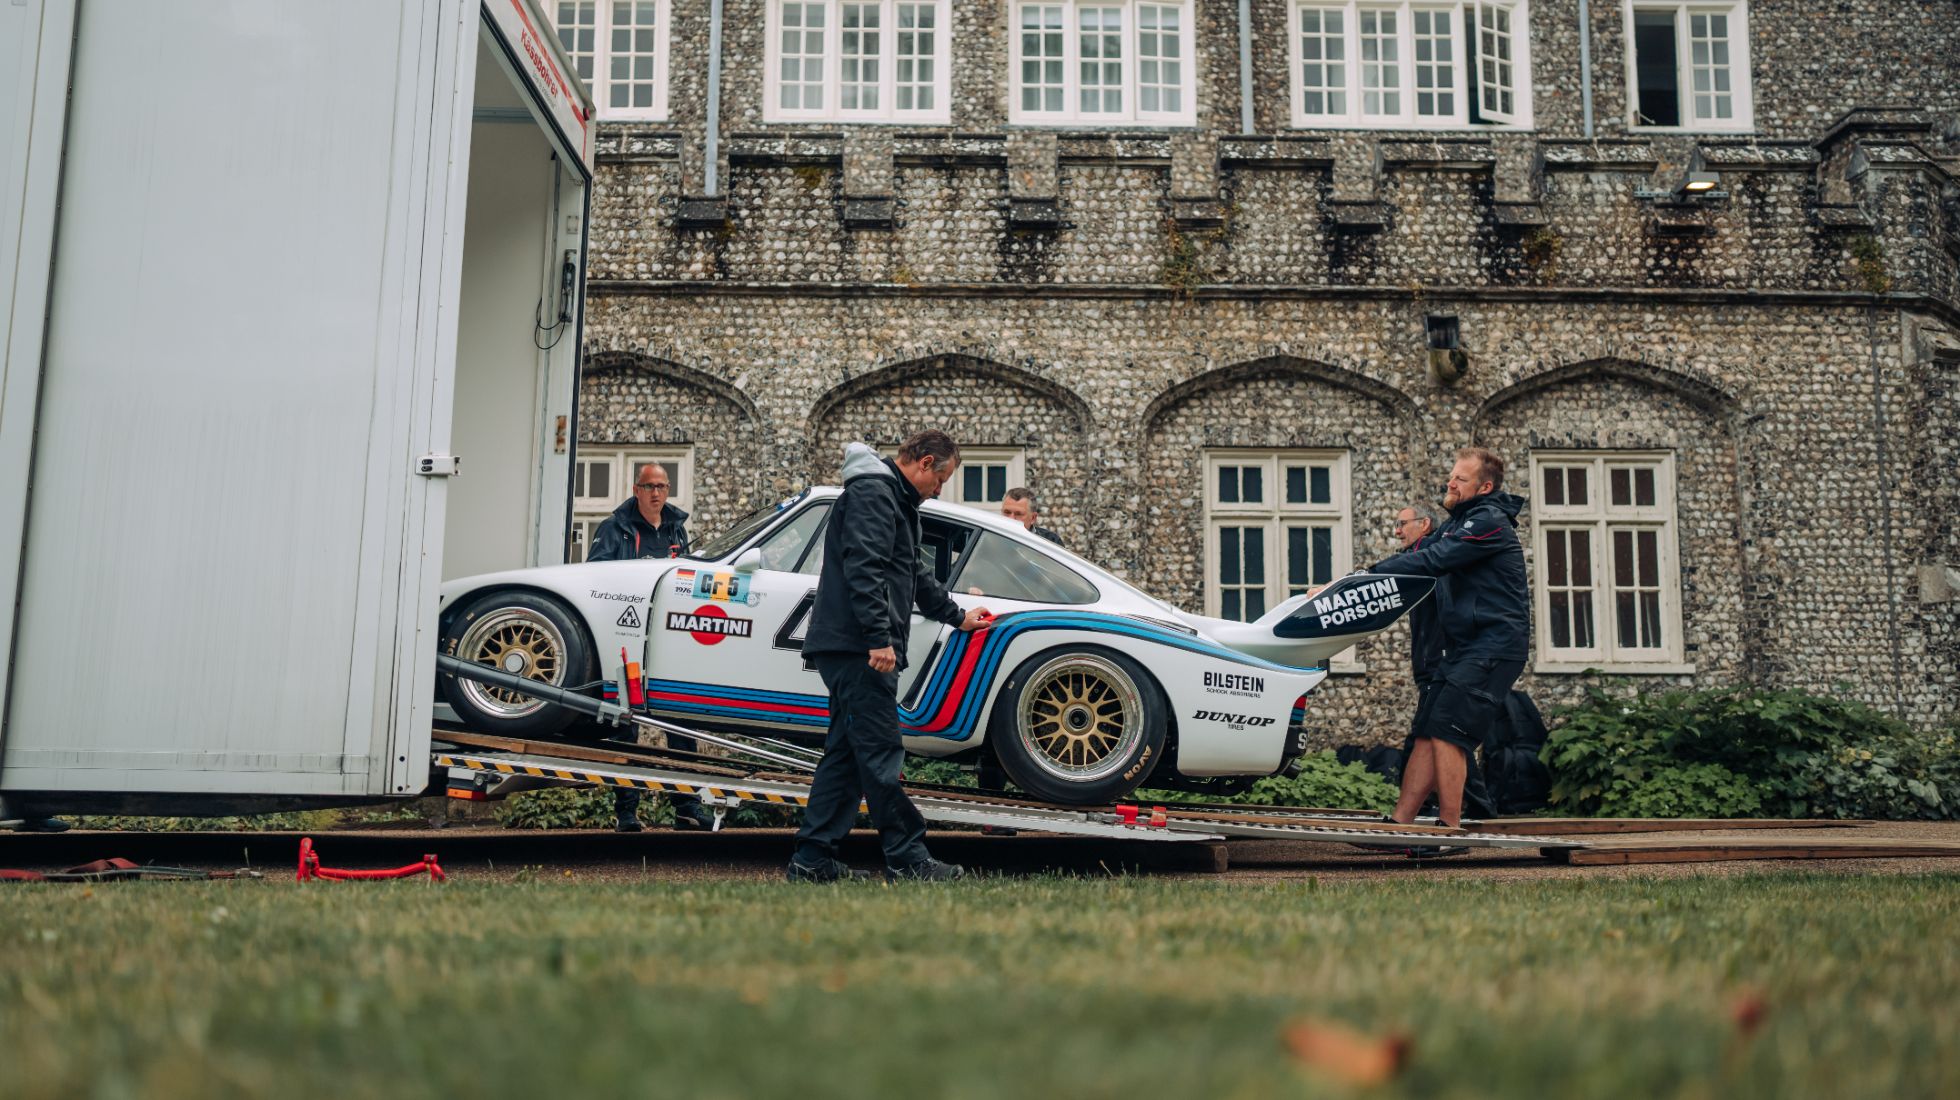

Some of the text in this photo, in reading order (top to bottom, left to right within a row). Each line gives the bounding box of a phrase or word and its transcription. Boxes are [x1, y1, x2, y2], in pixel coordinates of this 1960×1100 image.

[675, 586, 692, 594] 1976
[701, 574, 723, 595] Gr
[727, 576, 739, 596] 5
[589, 590, 646, 603] Turbolader
[1313, 577, 1399, 615] MARTINI
[1320, 593, 1404, 630] PORSCHE
[670, 614, 748, 635] MARTINI
[1204, 671, 1264, 692] BILSTEIN
[1192, 710, 1276, 727] DUNLOP
[1123, 744, 1152, 781] AVON
